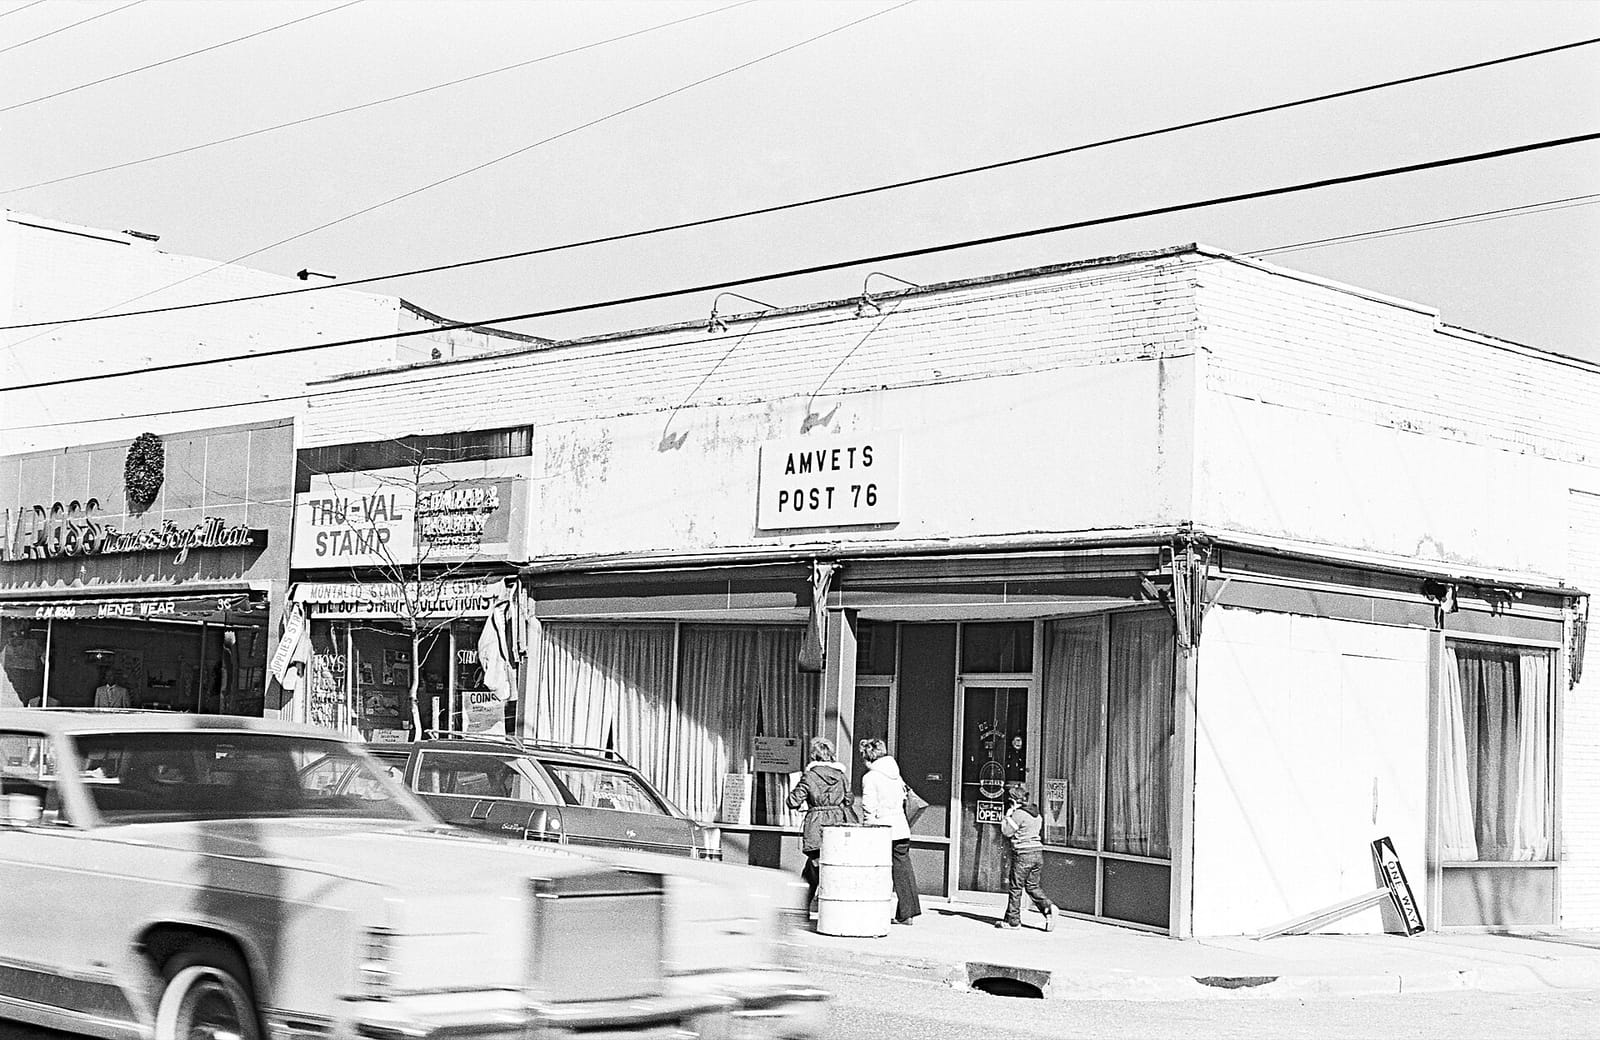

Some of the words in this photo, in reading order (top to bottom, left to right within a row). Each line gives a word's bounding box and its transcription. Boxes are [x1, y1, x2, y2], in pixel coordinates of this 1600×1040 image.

[785, 446, 873, 475] AMVETS
[309, 494, 403, 526] TRU-VAL
[779, 487, 835, 513] POST
[851, 484, 877, 507] 76
[316, 528, 391, 557] STAMP
[140, 602, 175, 616] WEAR
[979, 810, 1002, 821] OPEN
[1388, 861, 1404, 888] ONE
[1402, 896, 1418, 924] WAY
